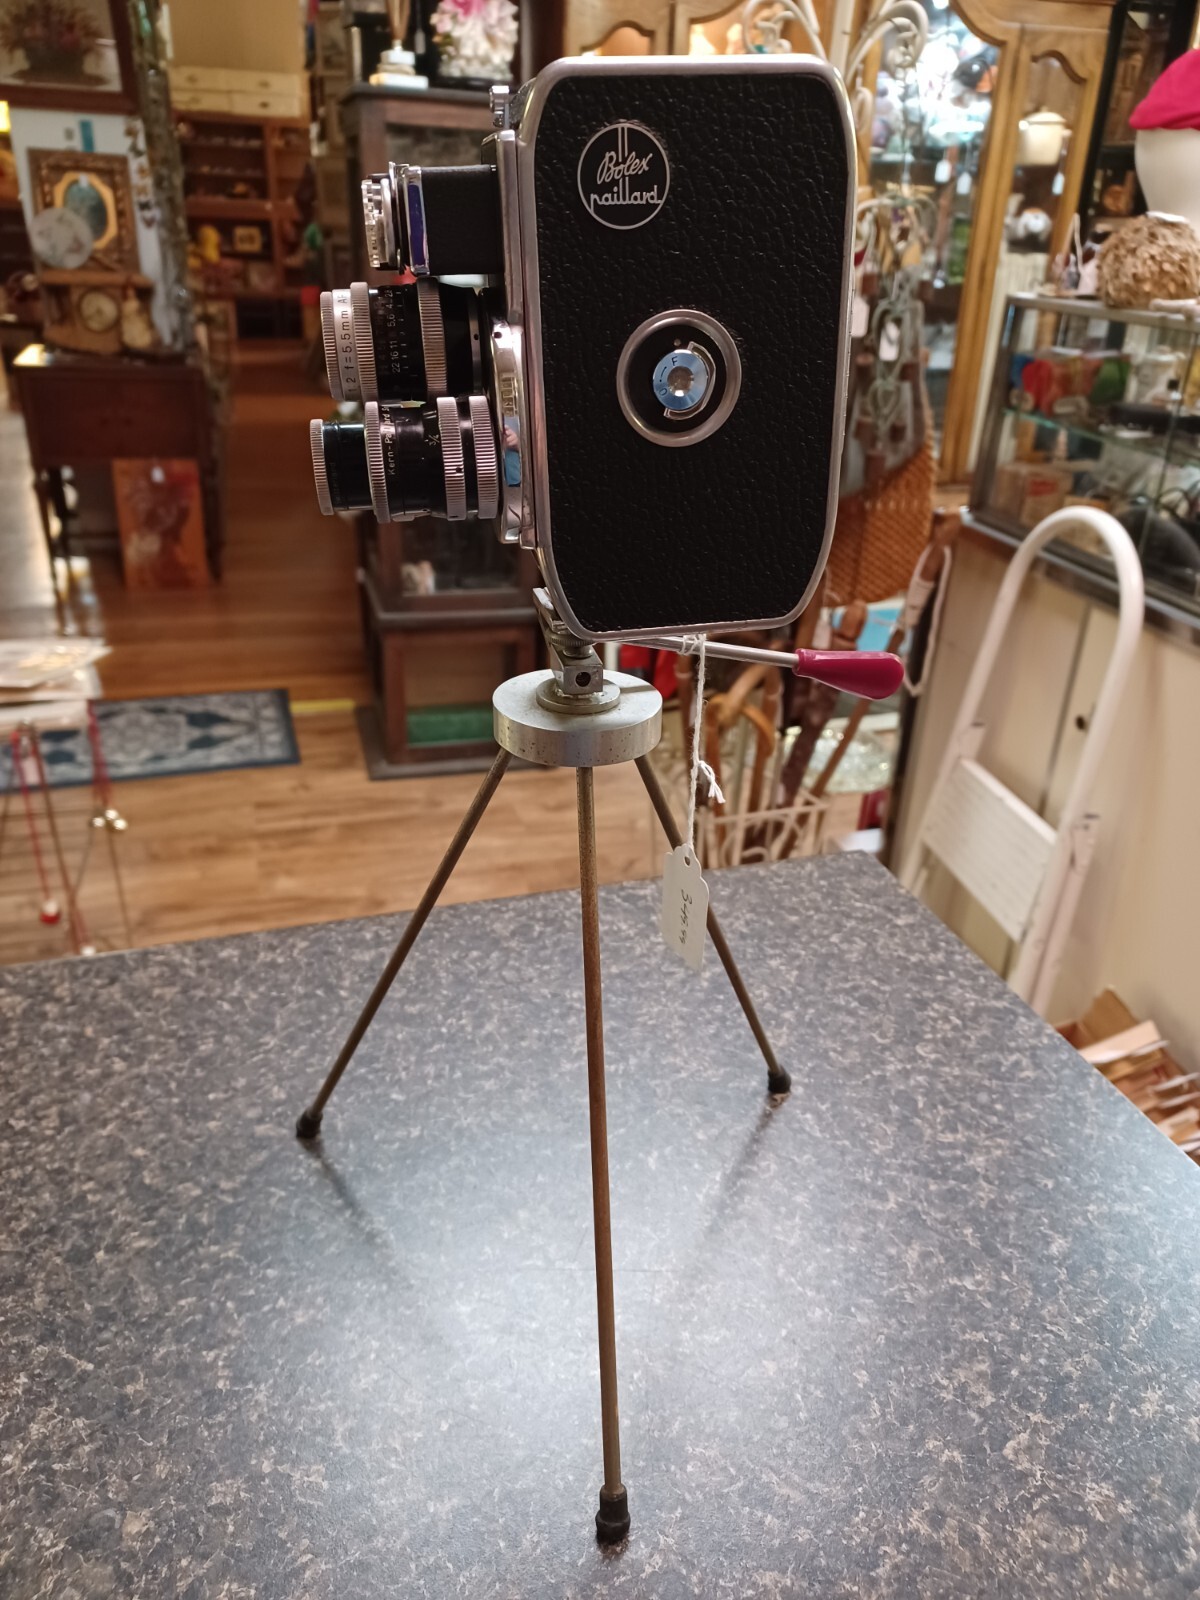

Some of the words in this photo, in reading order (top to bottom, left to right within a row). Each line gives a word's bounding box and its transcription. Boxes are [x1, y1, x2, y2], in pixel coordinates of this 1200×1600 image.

[597, 151, 653, 184] Bolex
[390, 350, 399, 360] 16
[671, 356, 678, 366] F
[392, 362, 401, 373] 22
